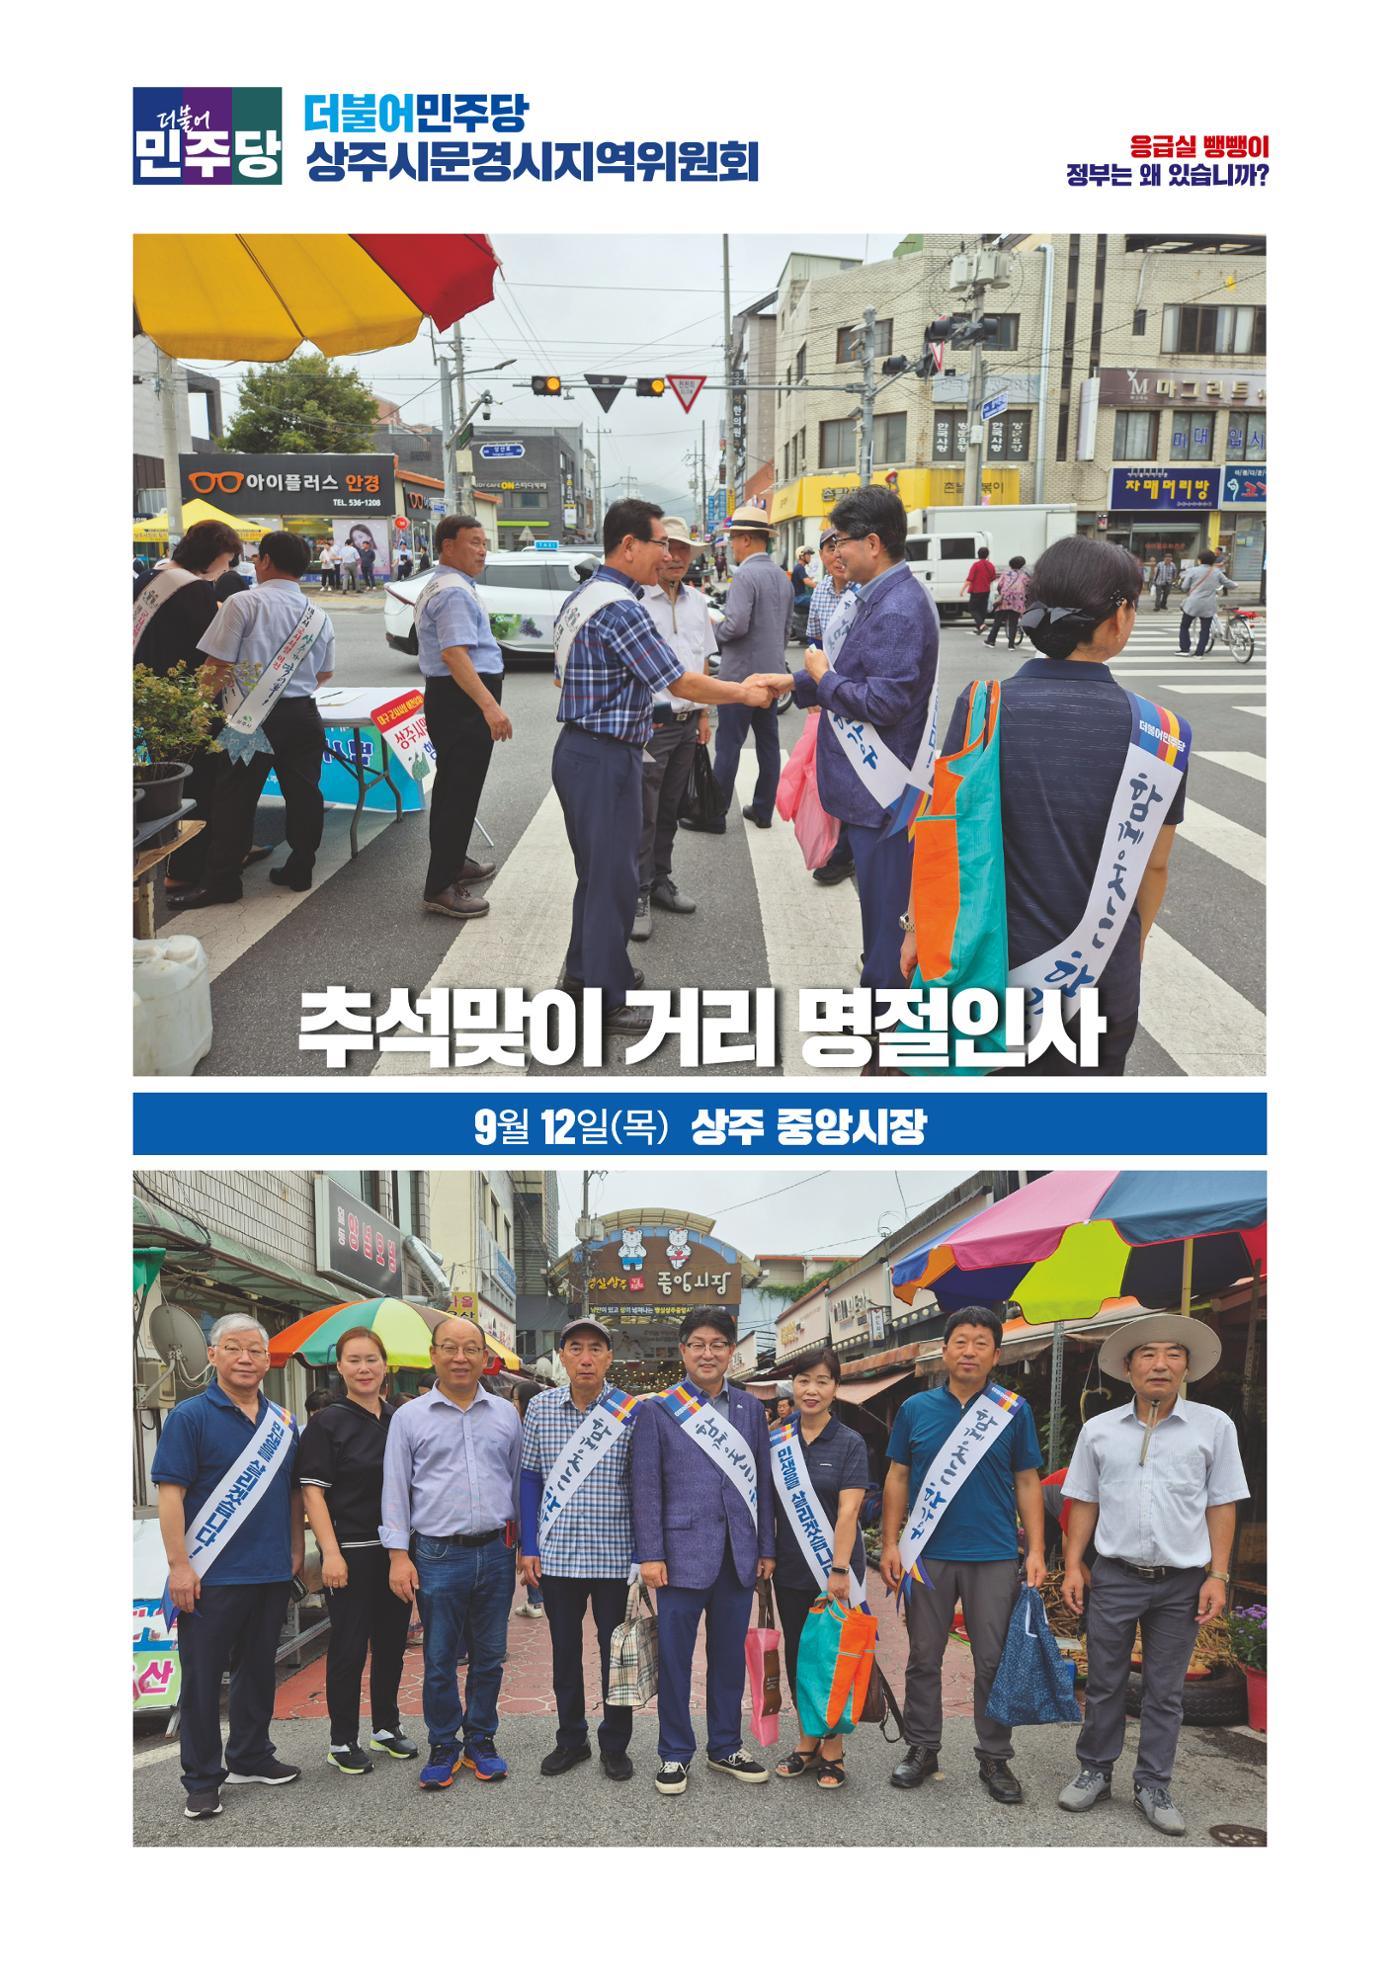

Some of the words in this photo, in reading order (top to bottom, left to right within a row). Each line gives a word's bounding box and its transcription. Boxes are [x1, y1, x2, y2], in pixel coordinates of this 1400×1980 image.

[1156, 378, 1249, 399] 마그리트
[246, 474, 339, 492] 아이플러스
[345, 475, 380, 493] 안경
[1125, 480, 1210, 500] 자매머리방
[1117, 773, 1164, 844] 함께
[657, 1271, 732, 1295] 중앙시장
